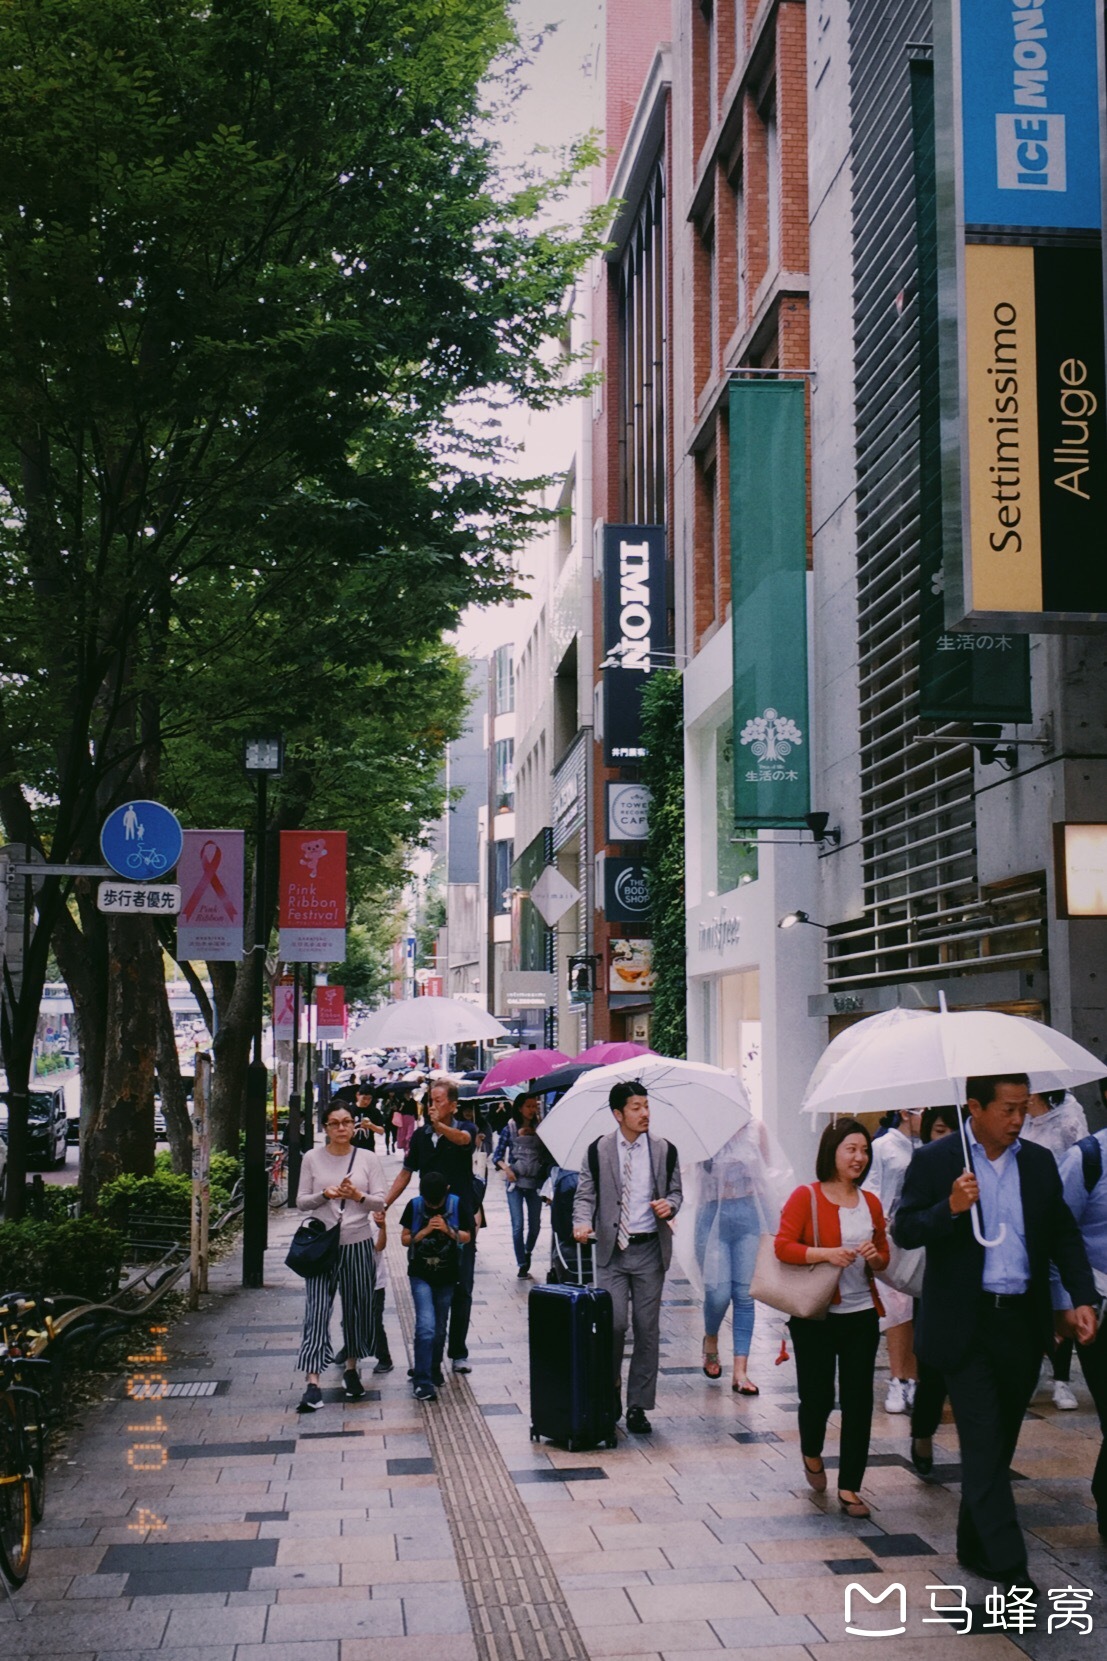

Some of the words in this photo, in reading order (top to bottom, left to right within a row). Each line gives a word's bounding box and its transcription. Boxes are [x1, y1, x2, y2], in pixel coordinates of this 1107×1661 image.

[1014, 118, 1049, 185] ICE
[986, 302, 1023, 553] Settimissimo
[1053, 358, 1098, 500] Alluge
[619, 540, 651, 673] IMON
[936, 634, 1013, 651] 生活の木
[744, 770, 799, 781] 生活の木
[288, 883, 317, 896] Pink
[103, 889, 175, 909] 歩行者優先
[288, 896, 337, 908] Ribbon
[287, 907, 339, 920] Festival
